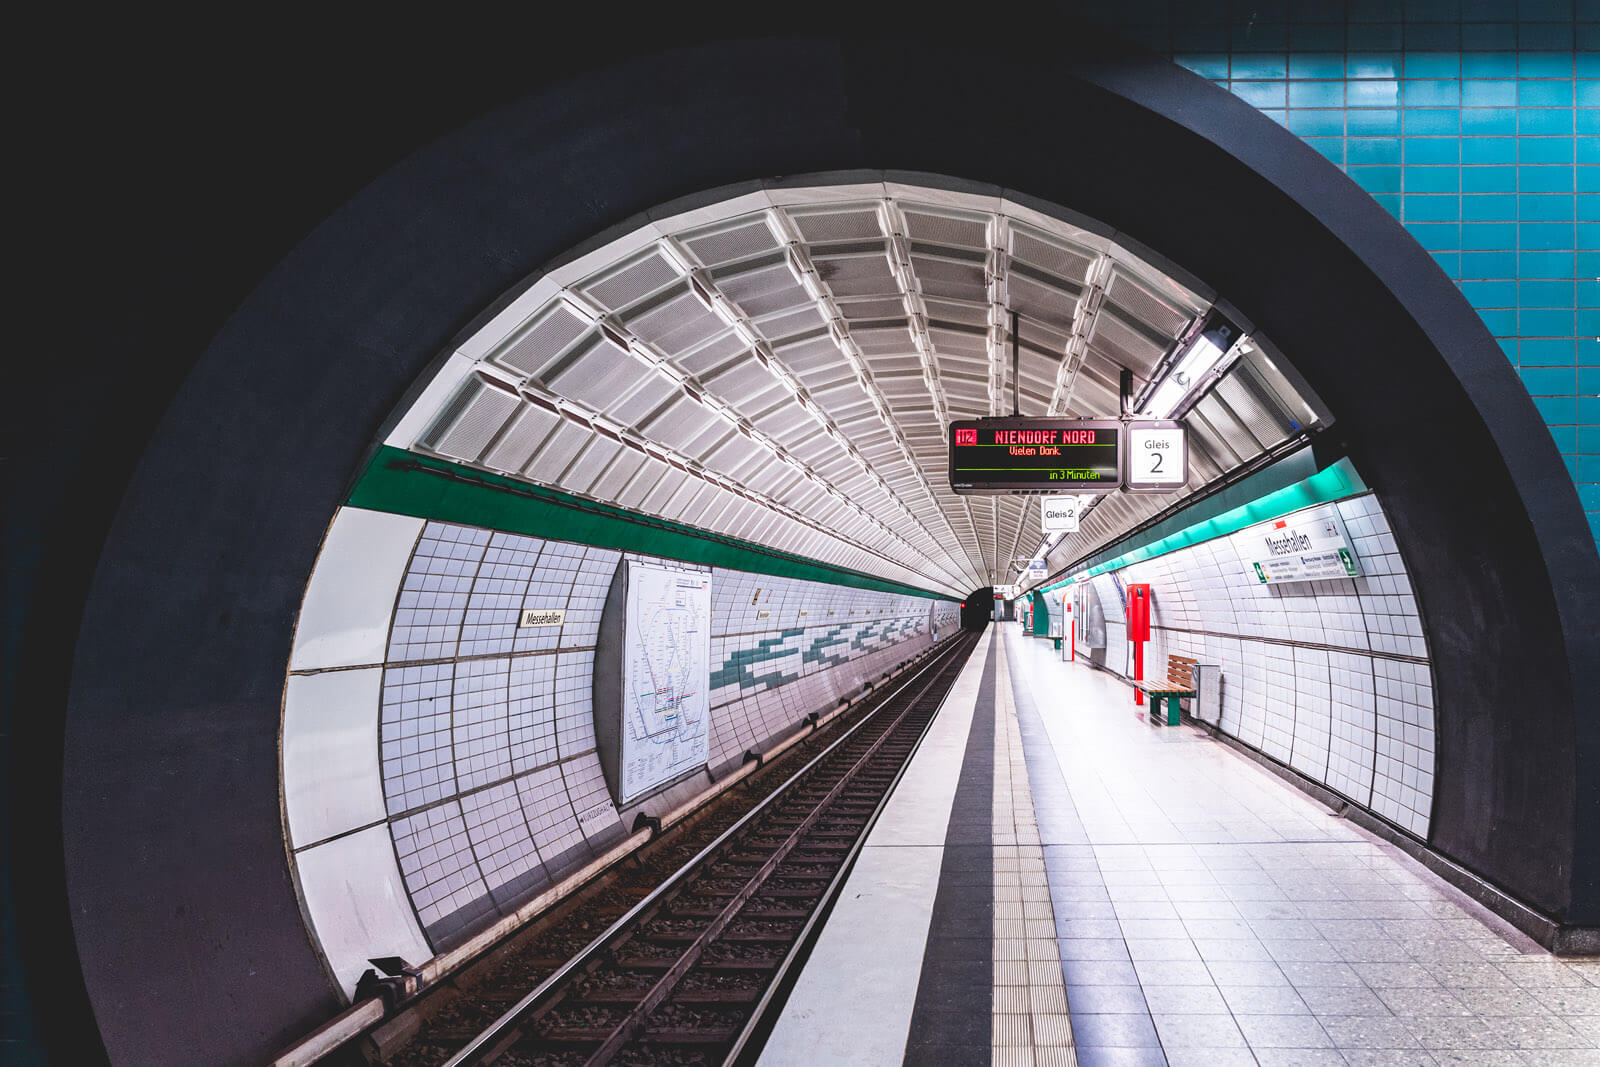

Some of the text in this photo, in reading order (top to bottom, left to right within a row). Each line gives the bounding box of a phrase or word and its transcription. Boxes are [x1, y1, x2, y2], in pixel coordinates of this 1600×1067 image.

[995, 430, 1096, 444] NIENDORF NORD
[1144, 439, 1170, 449] Gleis
[1009, 446, 1062, 456] Vielen Dank.
[1150, 453, 1164, 473] 2
[1049, 470, 1100, 480] in 3 Minuten
[1265, 529, 1312, 556] Messehallen
[526, 612, 561, 624] Messehallen
